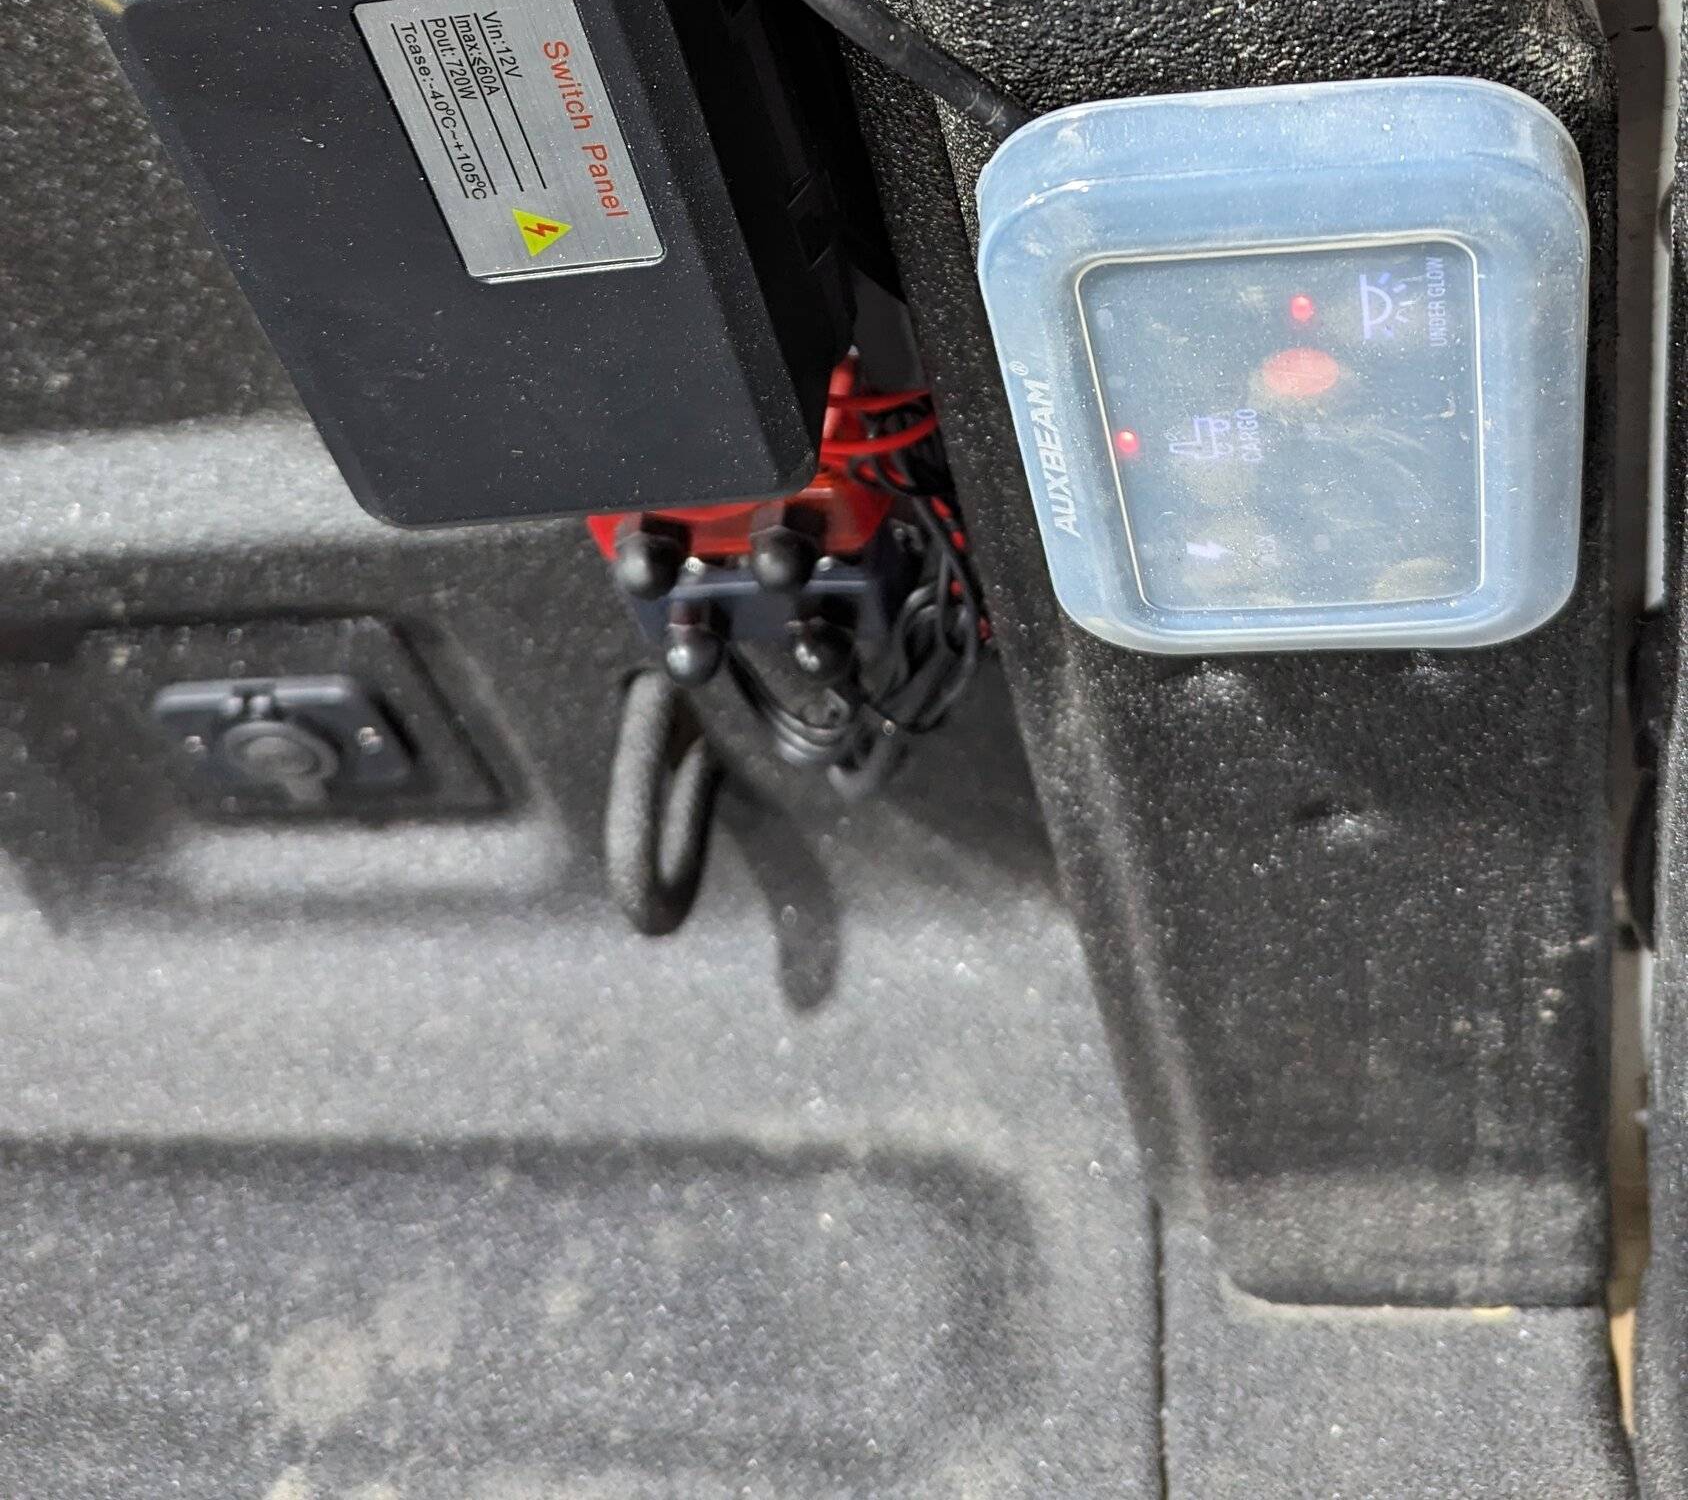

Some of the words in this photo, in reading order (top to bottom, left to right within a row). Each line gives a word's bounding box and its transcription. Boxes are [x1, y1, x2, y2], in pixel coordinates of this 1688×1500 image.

[542, 41, 594, 130] Switch
[581, 143, 630, 218] Panel
[1426, 257, 1446, 297] GLOW
[1428, 300, 1447, 347] UNDER
[1236, 408, 1263, 462] CARGO
